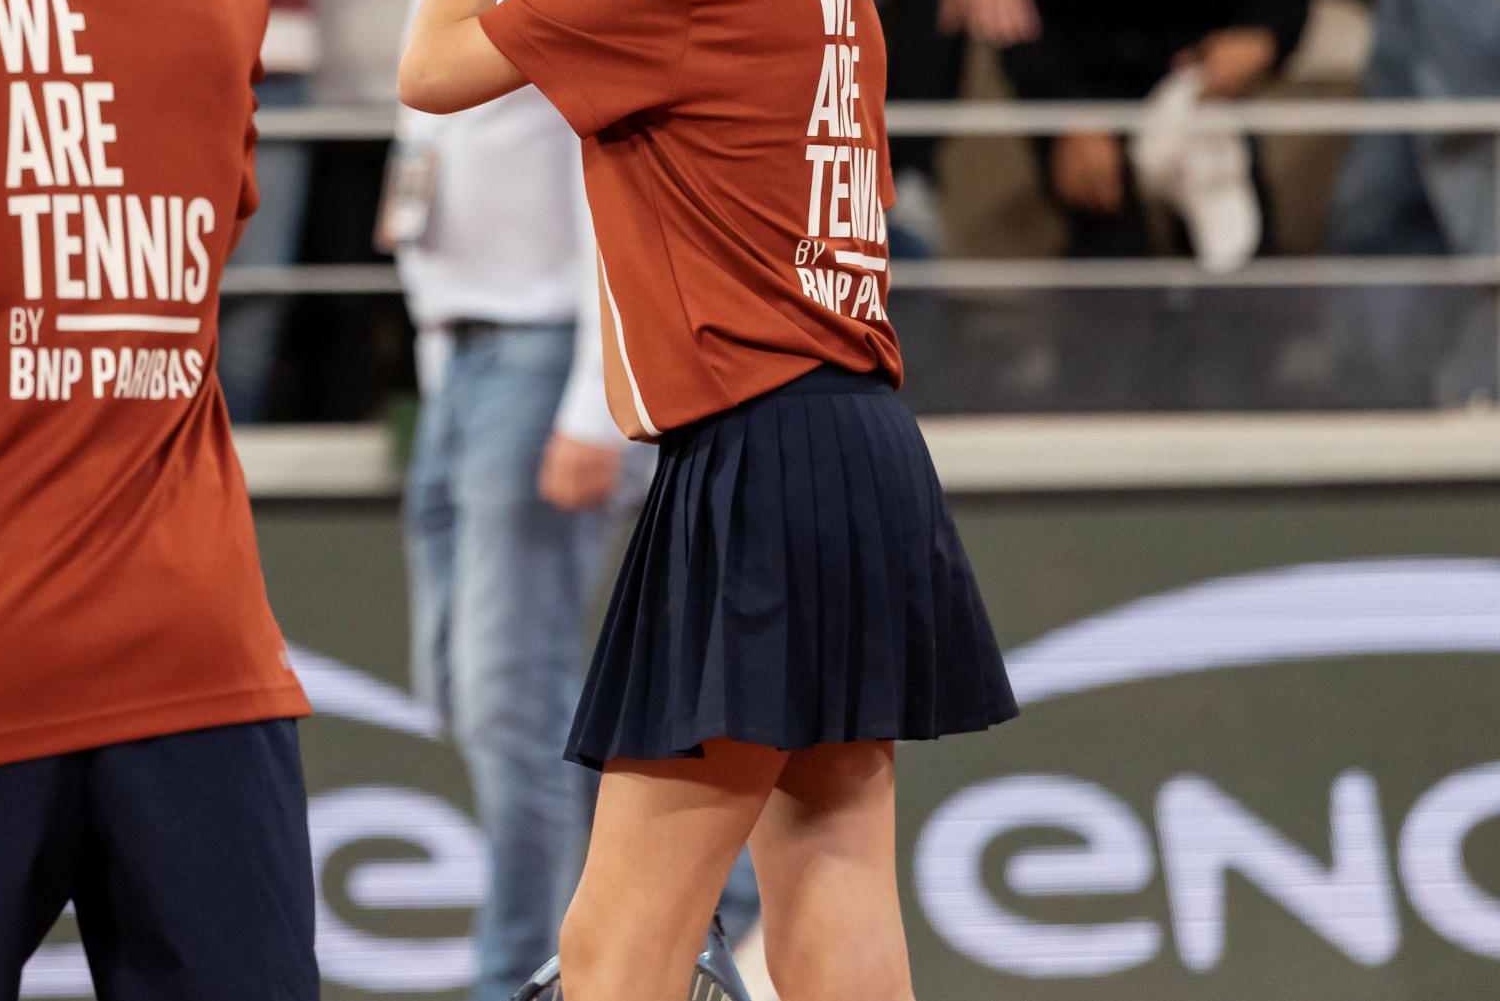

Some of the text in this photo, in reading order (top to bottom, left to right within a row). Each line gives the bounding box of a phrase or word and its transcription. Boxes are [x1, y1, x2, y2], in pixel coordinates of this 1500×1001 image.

[806, 44, 861, 139] ARE
[6, 81, 124, 188] ARE
[7, 194, 216, 305] TENNIS
[795, 239, 826, 266] BY
[796, 267, 889, 321] BNP PA
[9, 307, 45, 345] BY
[9, 346, 204, 401] BNP PARIBAS
